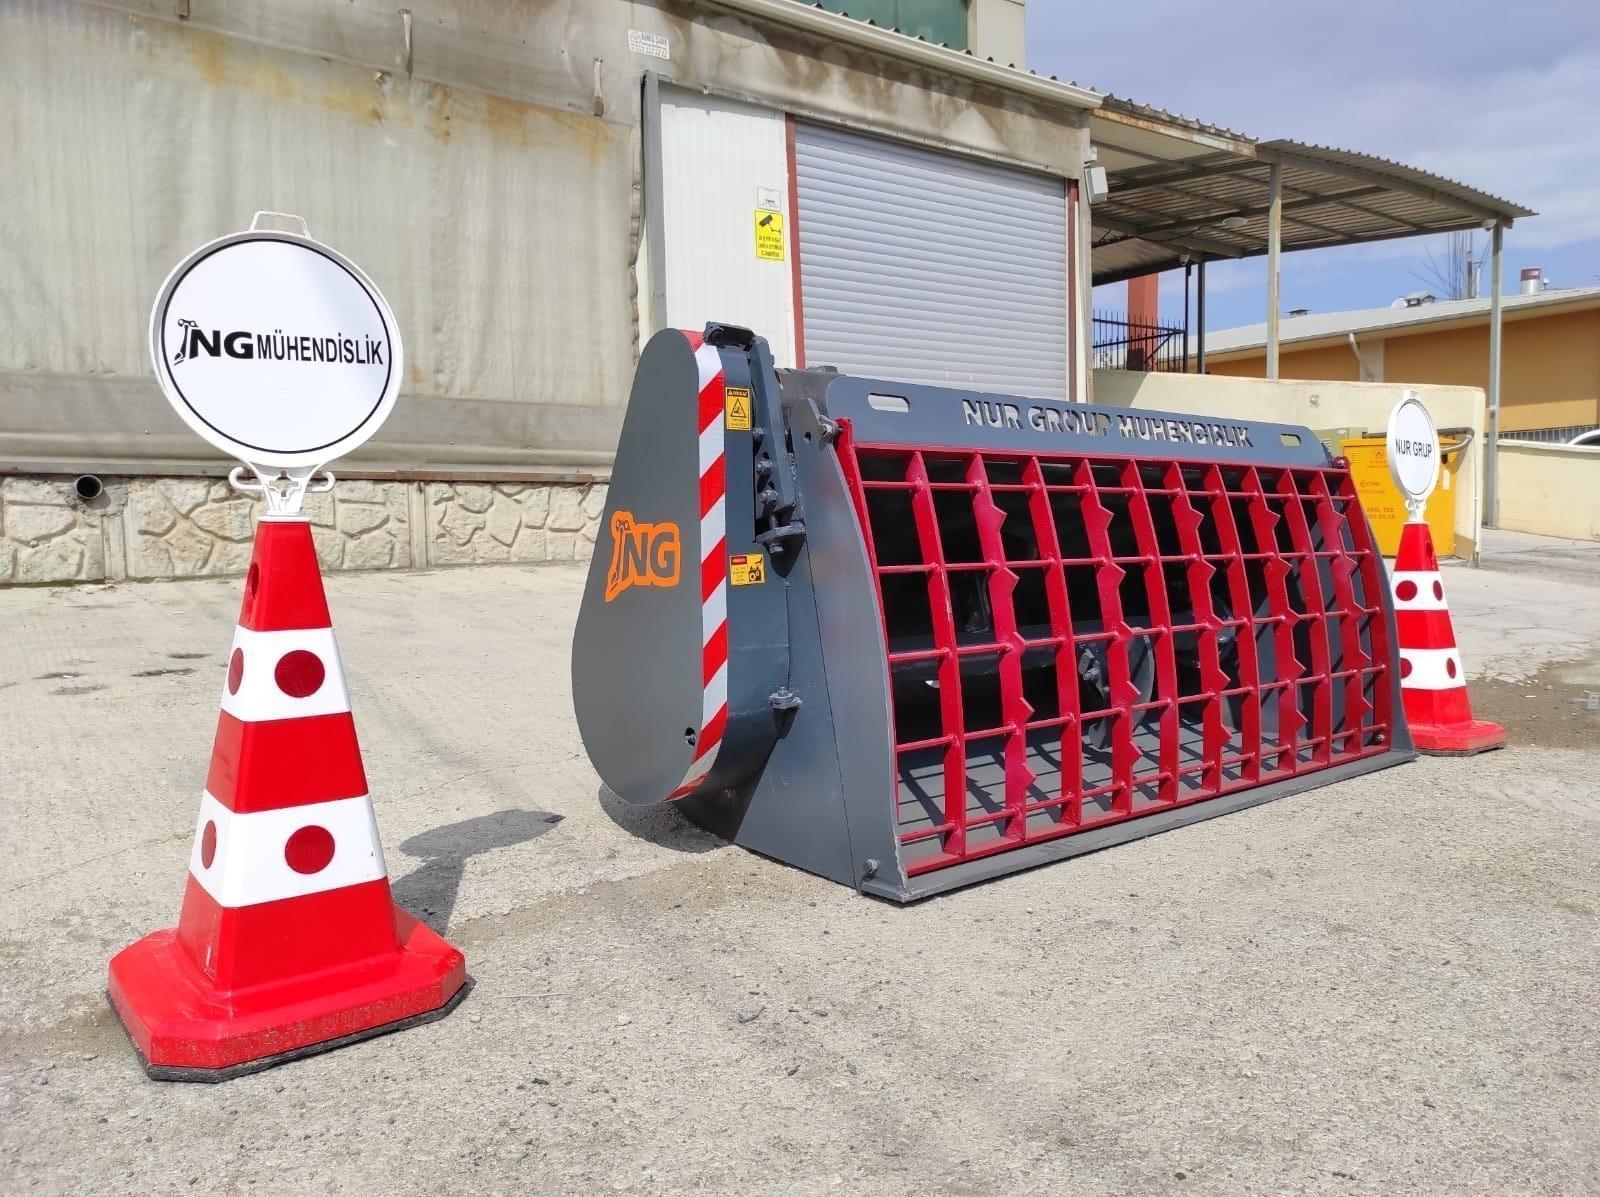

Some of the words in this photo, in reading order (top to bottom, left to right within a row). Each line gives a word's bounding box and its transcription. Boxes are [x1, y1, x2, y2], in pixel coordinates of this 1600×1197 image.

[256, 329, 384, 365] MÜHENDİSLİK
[962, 398, 1024, 430] NUR
[1027, 405, 1112, 437] GROUP
[1395, 439, 1412, 456] NUR
[1412, 441, 1433, 458] GRUP
